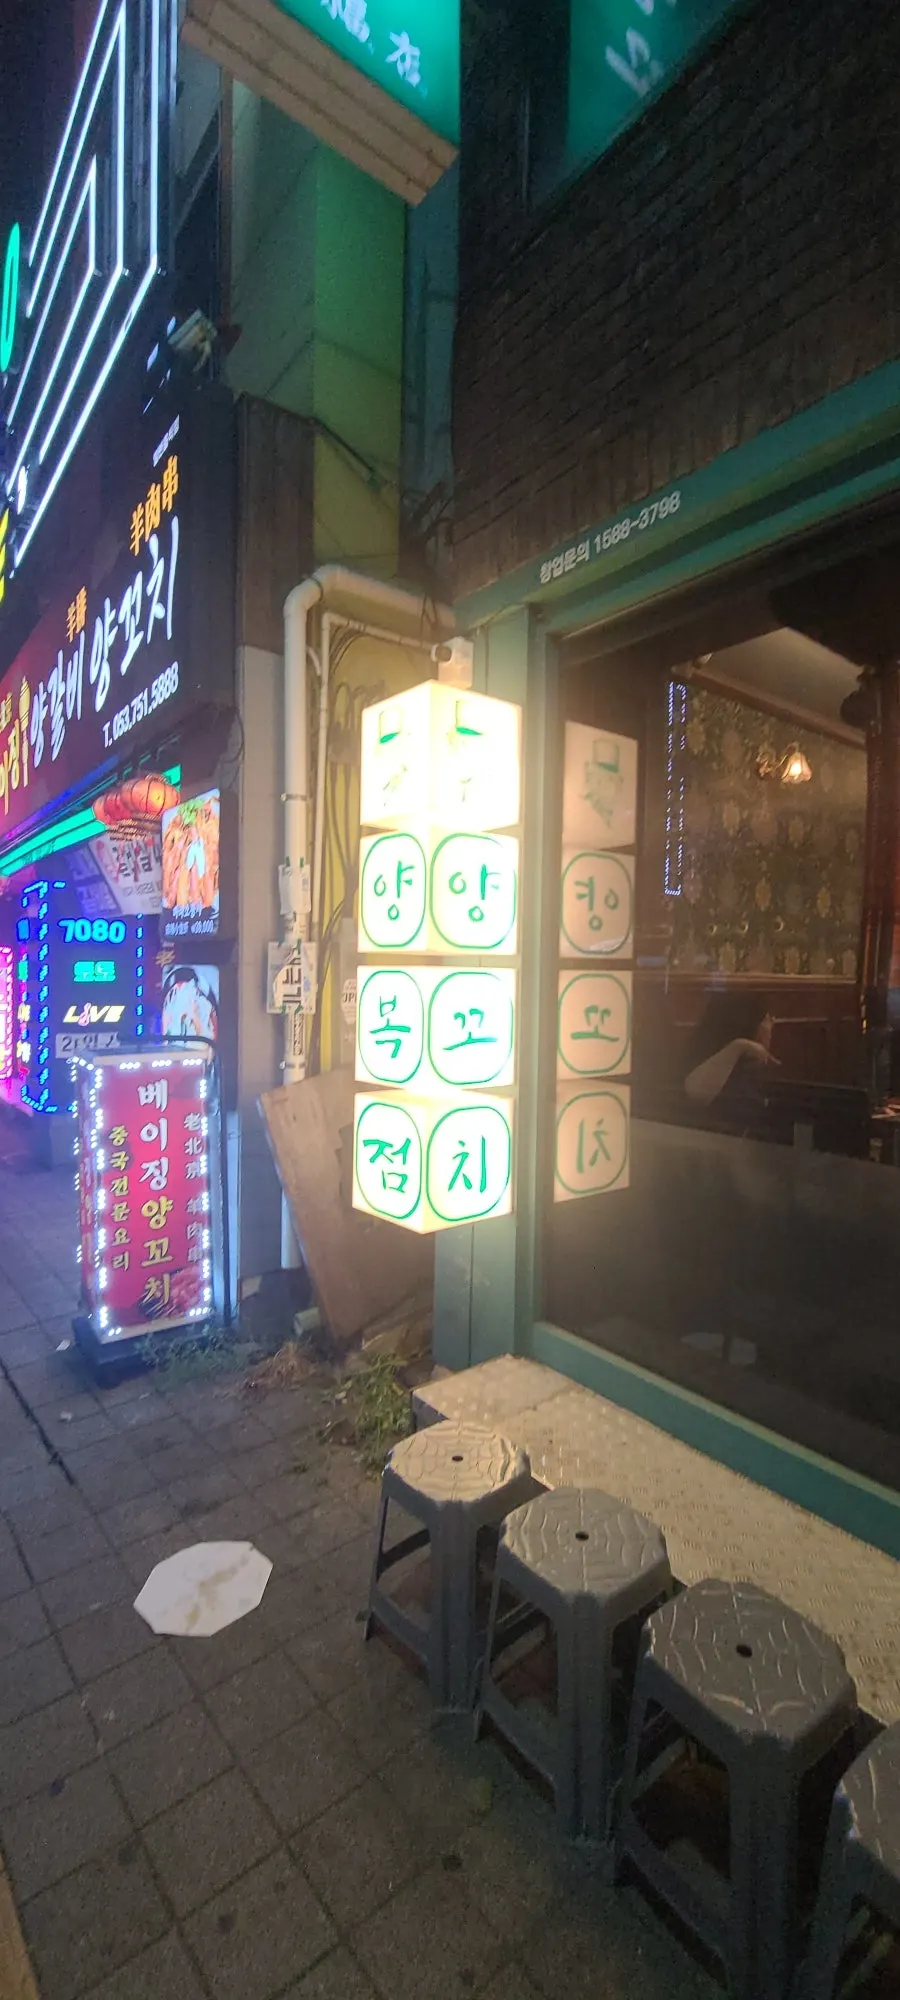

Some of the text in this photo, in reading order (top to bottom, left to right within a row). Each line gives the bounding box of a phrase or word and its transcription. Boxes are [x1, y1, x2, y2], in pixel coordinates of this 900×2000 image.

[130, 455, 179, 556] 羊肉串
[540, 490, 681, 584] 창업문의 1588-3798
[30, 630, 86, 769] 양갈비
[89, 516, 179, 712] 양꼬치
[57, 918, 127, 944] 7080
[363, 861, 415, 1193] 양복점
[443, 864, 501, 1193] 양꼬치
[107, 1124, 130, 1272] 중국전문요리
